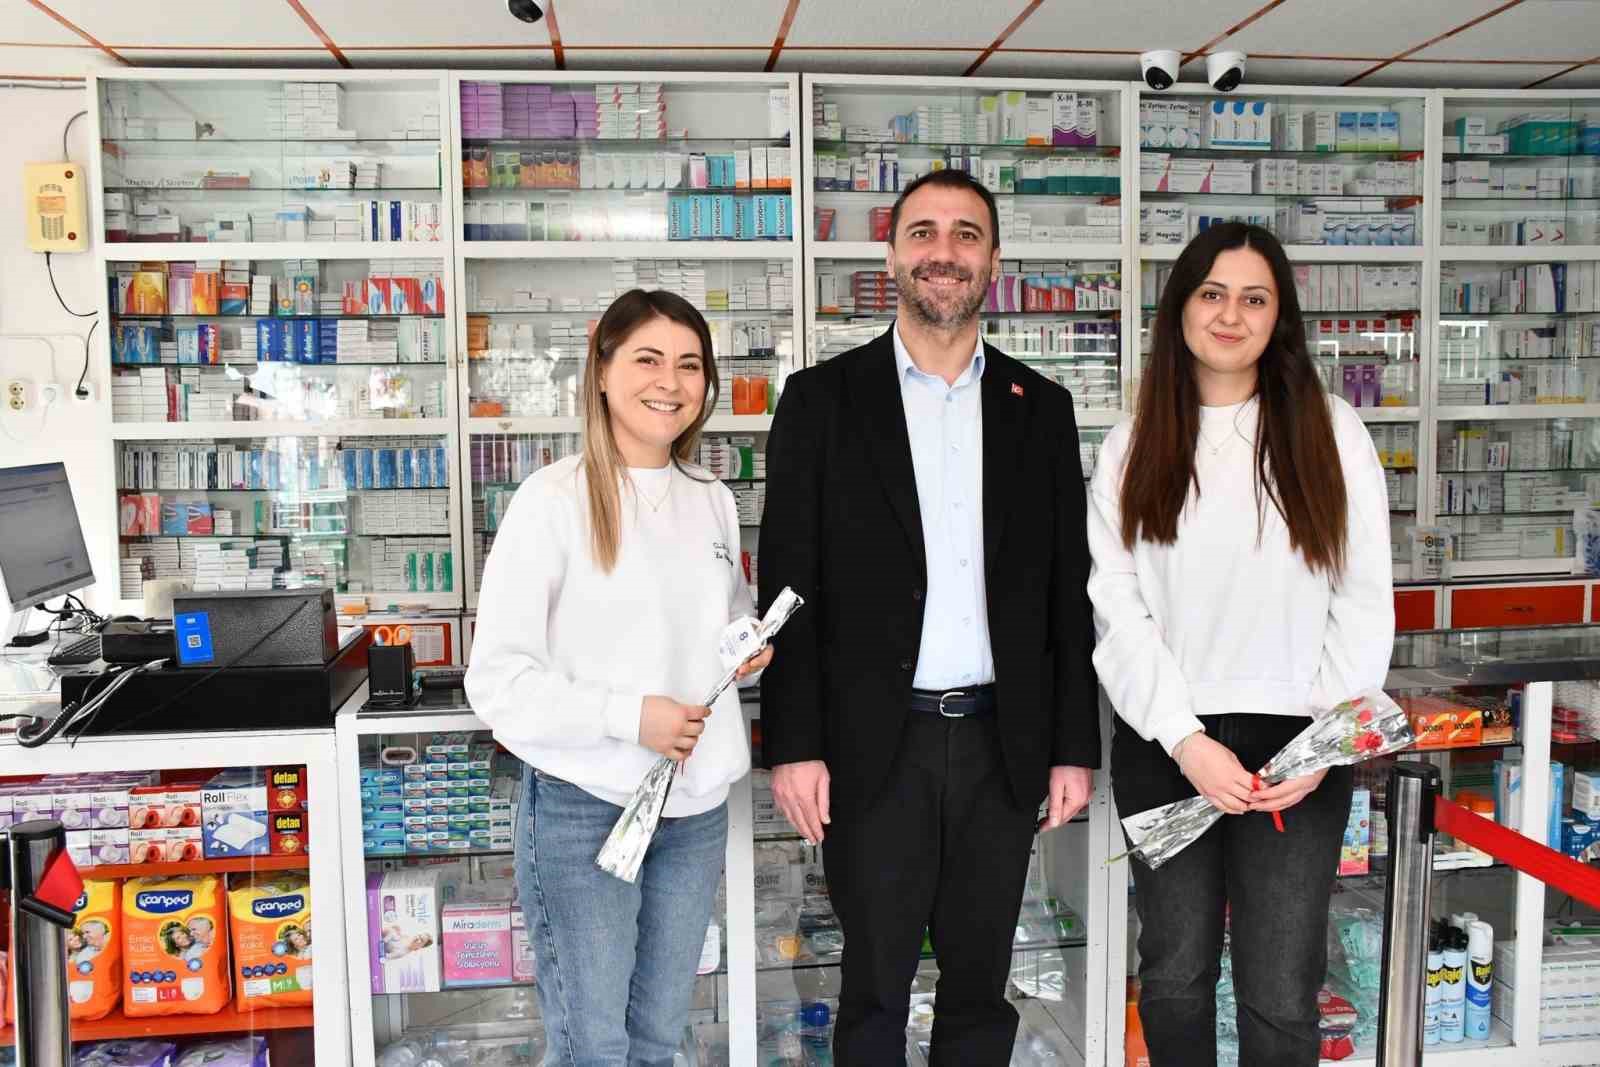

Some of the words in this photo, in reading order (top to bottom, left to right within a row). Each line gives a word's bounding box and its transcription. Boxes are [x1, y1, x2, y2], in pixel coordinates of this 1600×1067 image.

[273, 771, 298, 785] detan
[276, 816, 301, 830] detan
[142, 893, 190, 908] canped
[259, 899, 302, 914] canped
